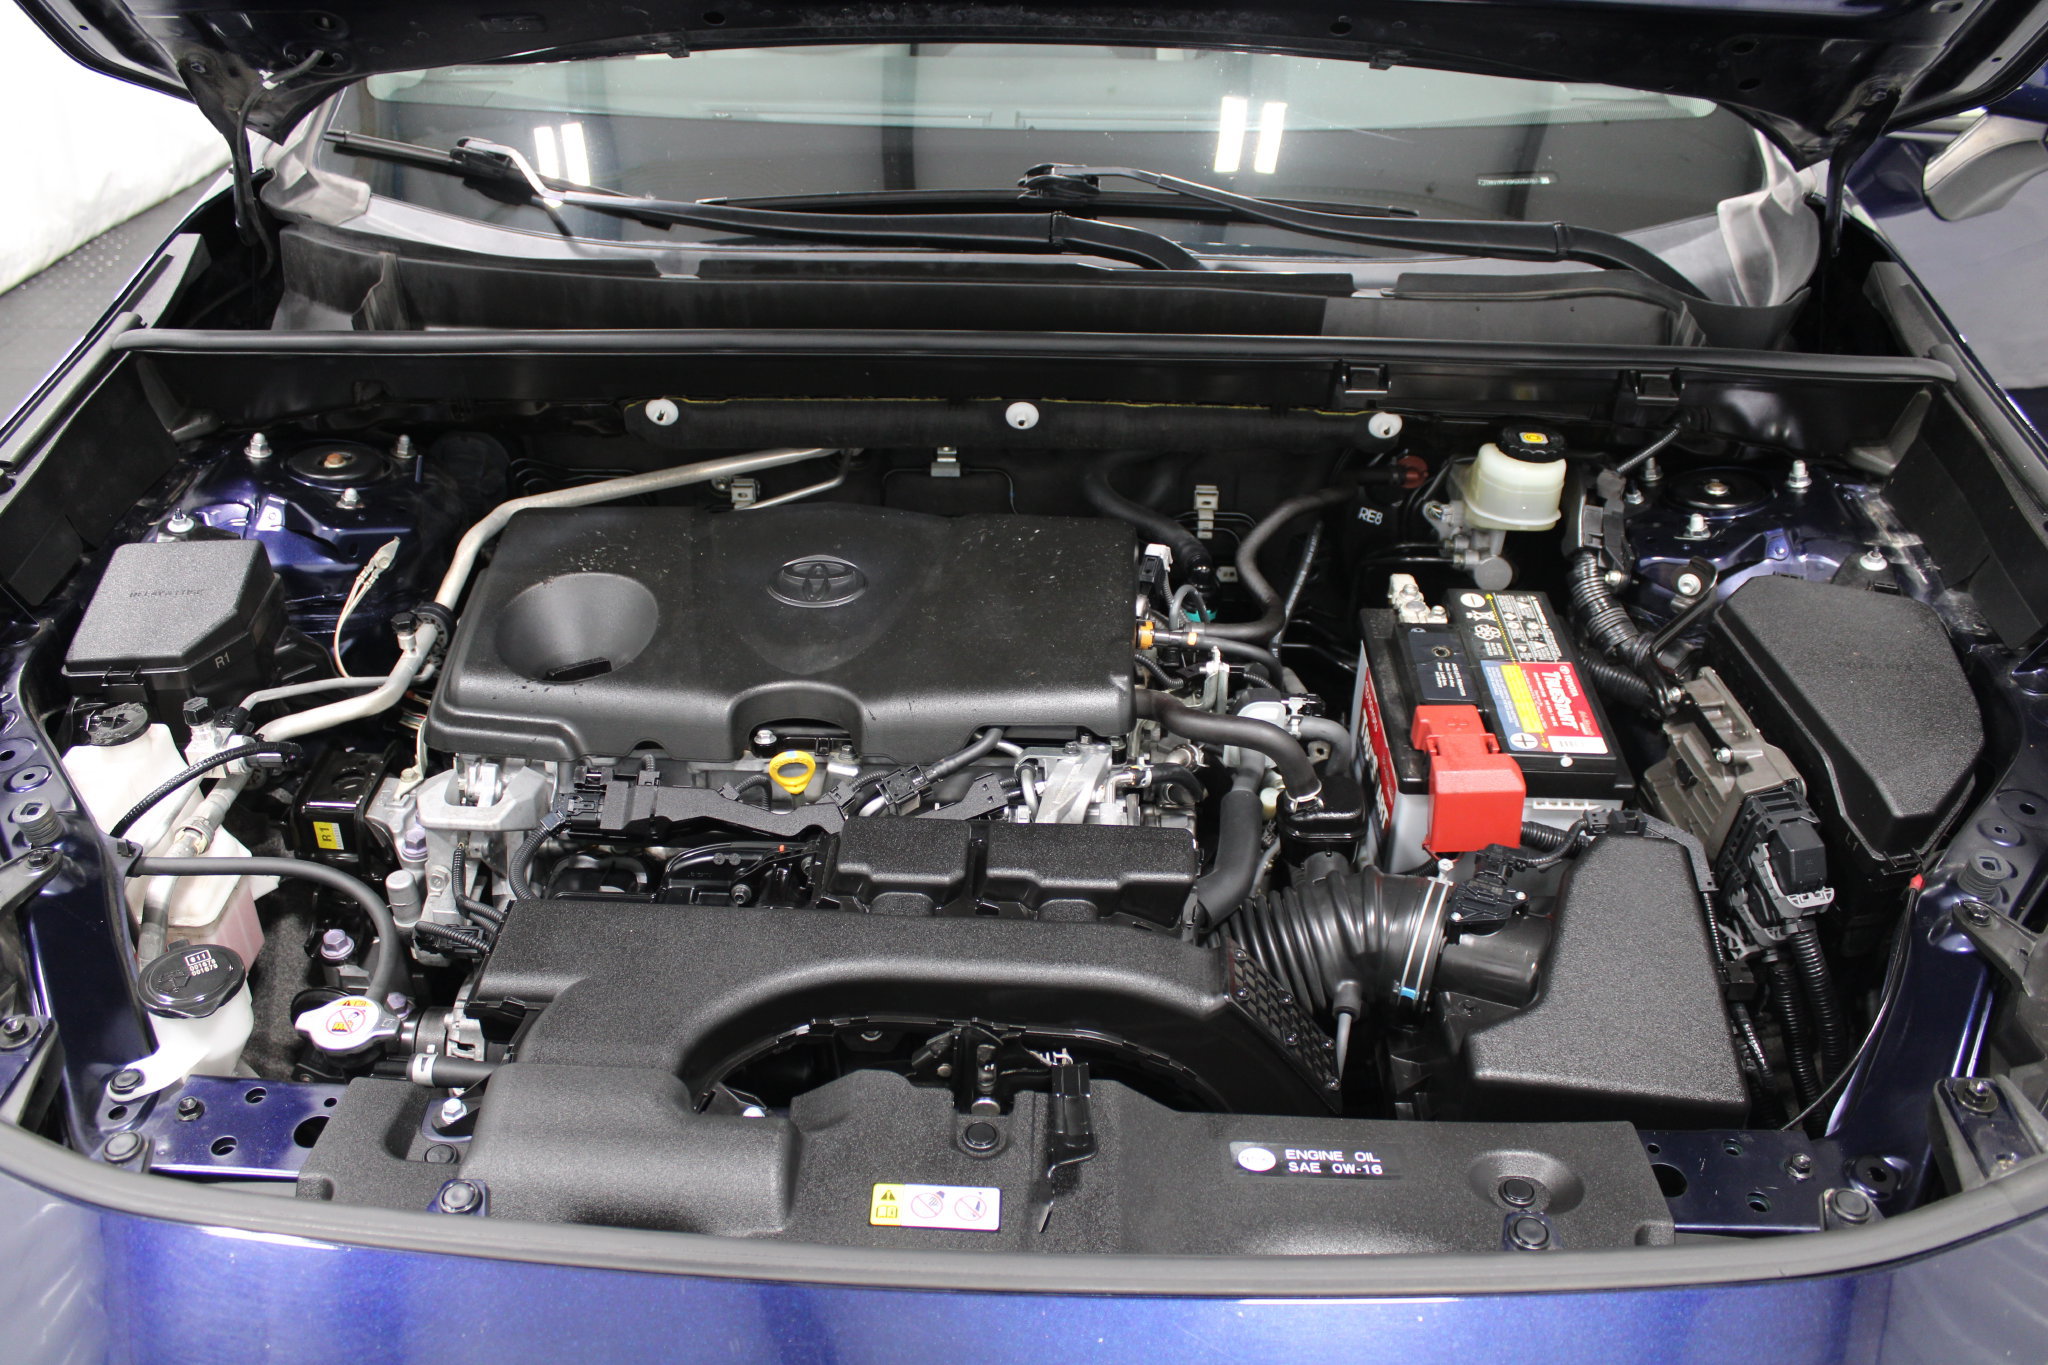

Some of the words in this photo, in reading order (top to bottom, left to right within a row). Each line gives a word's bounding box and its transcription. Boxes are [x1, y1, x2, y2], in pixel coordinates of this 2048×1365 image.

[1358, 506, 1383, 525] RE8
[214, 651, 231, 669] R1
[1285, 1149, 1344, 1162] ENGINE
[1354, 1151, 1381, 1163] OIL
[1288, 1161, 1322, 1173] SAE
